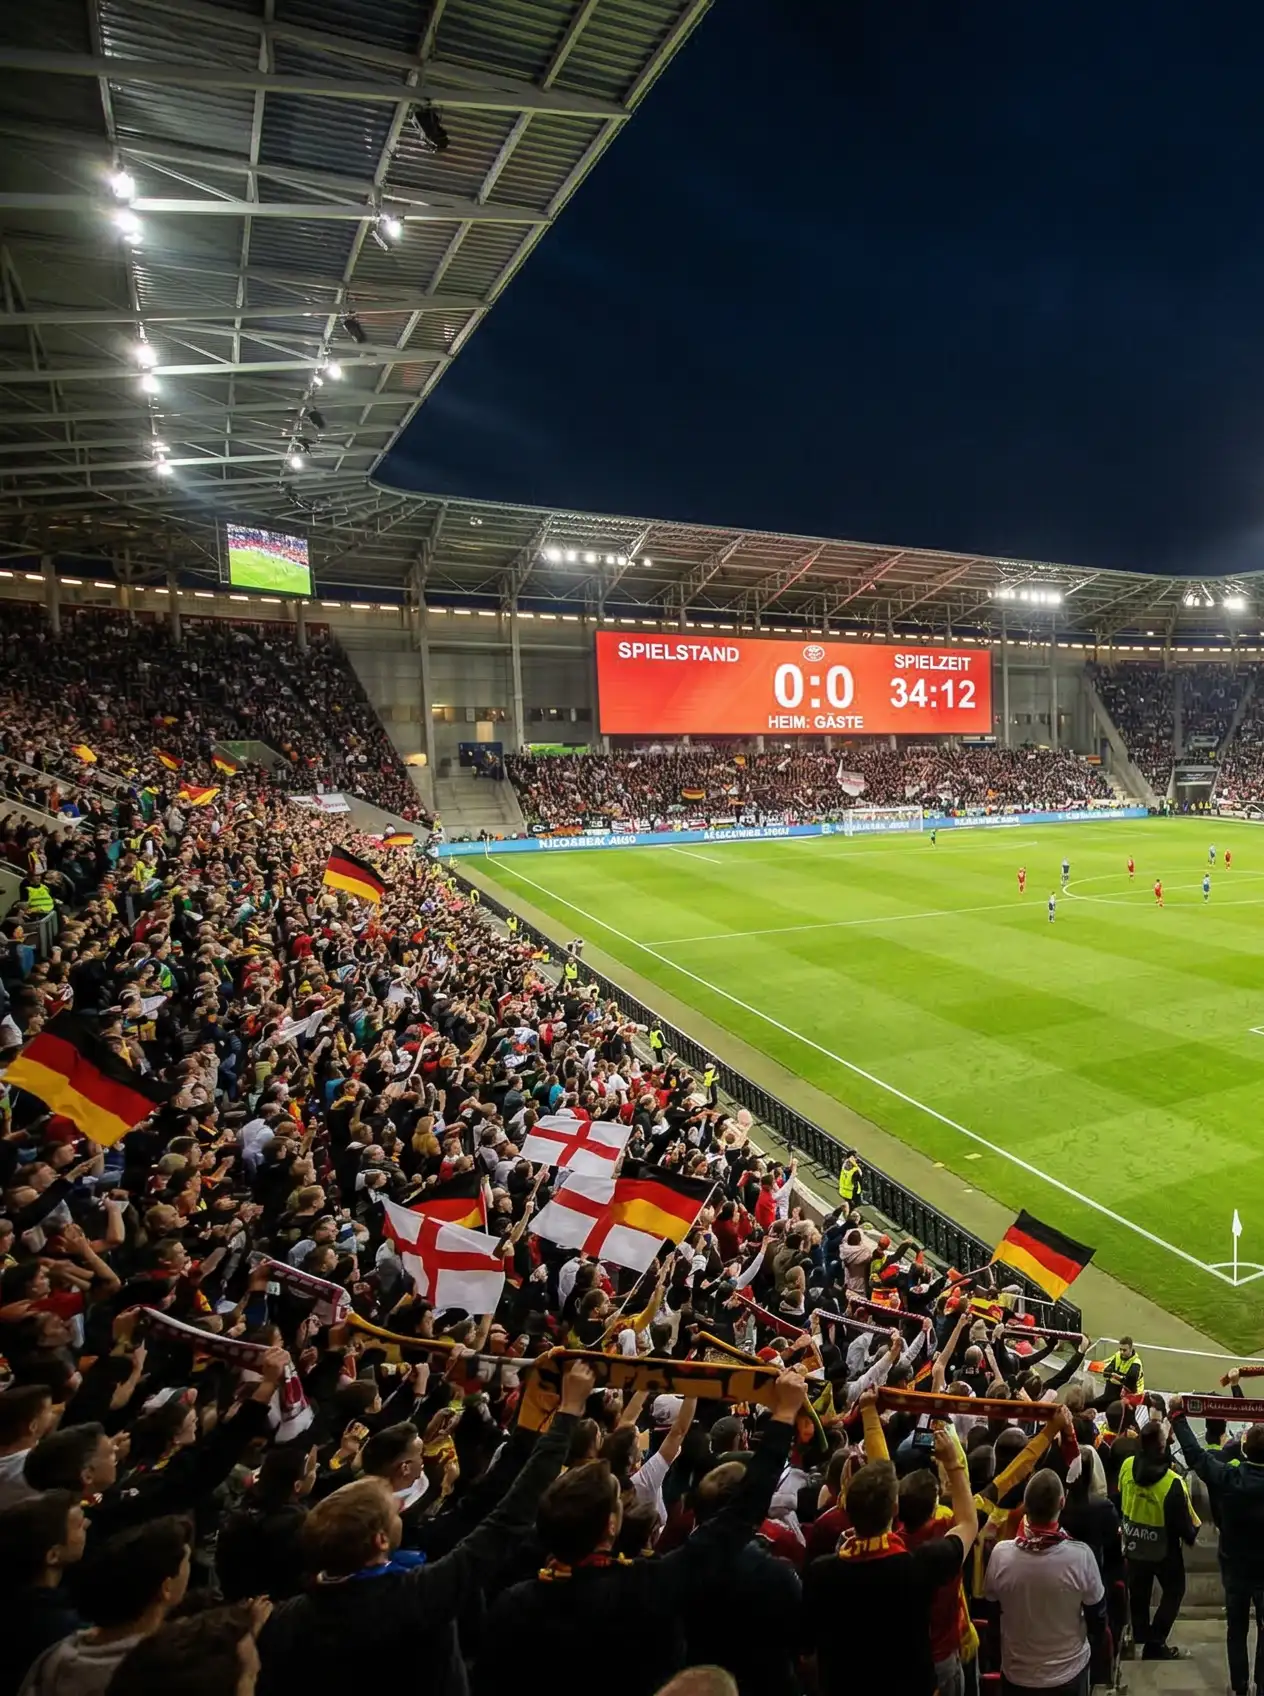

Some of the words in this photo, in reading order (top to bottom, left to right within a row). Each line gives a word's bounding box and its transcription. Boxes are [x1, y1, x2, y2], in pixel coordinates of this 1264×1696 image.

[618, 641, 740, 663] SPIELSTAND
[894, 654, 972, 672] SPIELZEIT
[774, 663, 854, 709] 0:0
[889, 677, 976, 709] 34:12
[768, 715, 811, 729] HEIM:
[813, 711, 864, 729] GÄSTE
